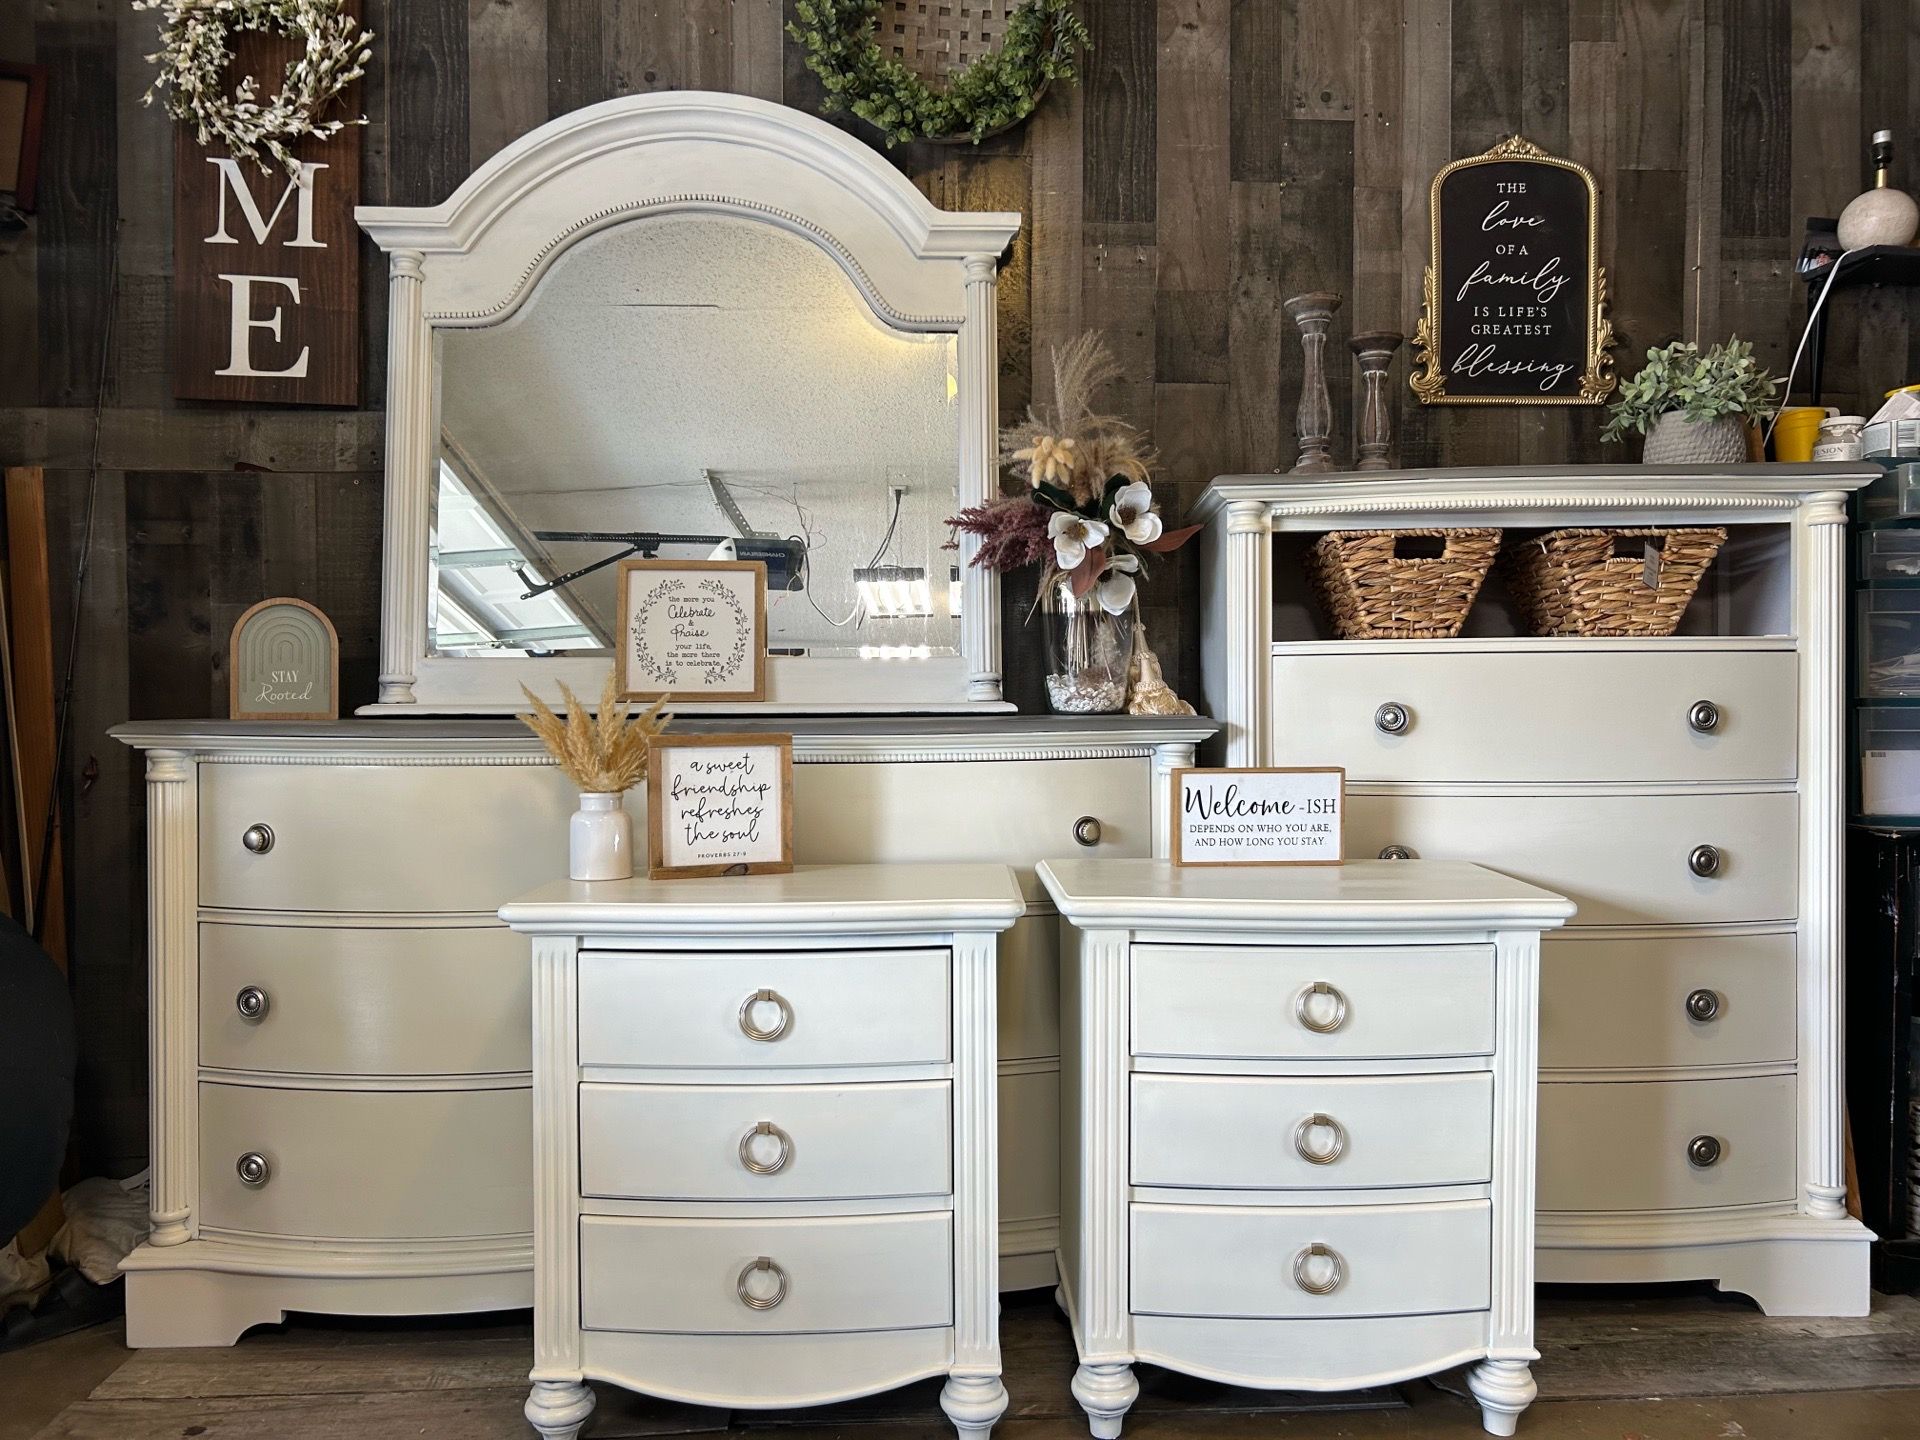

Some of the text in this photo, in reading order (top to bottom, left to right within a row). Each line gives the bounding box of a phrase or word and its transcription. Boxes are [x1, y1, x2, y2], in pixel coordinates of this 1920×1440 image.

[1496, 182, 1527, 194] THE
[1481, 200, 1545, 231] love
[1496, 244, 1529, 255] OF A
[1456, 256, 1571, 303] family
[1474, 306, 1548, 317] IS LIFE'S
[1470, 324, 1552, 335] GREATEST
[1450, 343, 1574, 391] blessing
[667, 604, 716, 619] Celebrate
[670, 623, 709, 641] Praise
[271, 670, 299, 683] STAY
[255, 681, 313, 704] Rooted
[690, 752, 754, 775] a sweet
[670, 774, 771, 801] friendship
[681, 796, 764, 823] refreshes
[1185, 784, 1295, 820] Welcome
[684, 818, 760, 846] the soul
[1189, 823, 1332, 833] DEPENDS ON WHO YOU ARE,
[1194, 837, 1216, 847] AND
[1219, 838, 1243, 847] HOW
[1246, 837, 1274, 846] LONG
[1277, 837, 1299, 846] YOU
